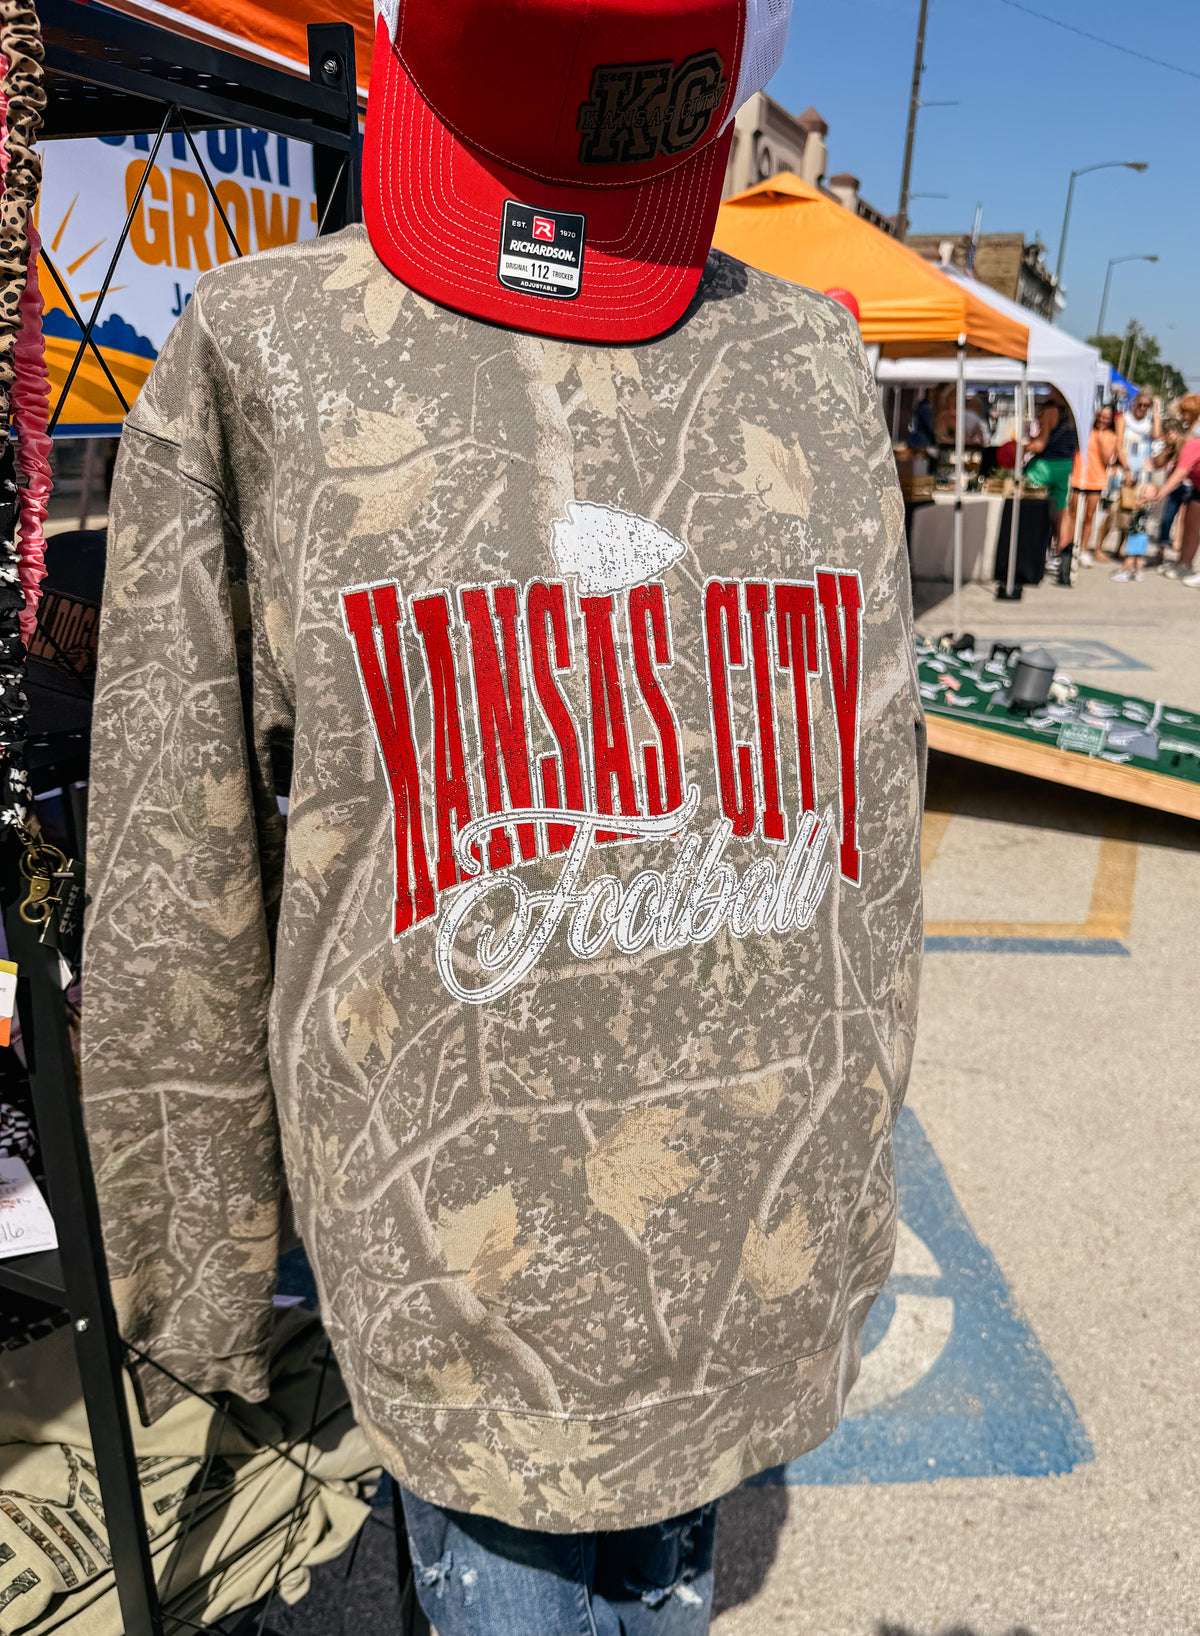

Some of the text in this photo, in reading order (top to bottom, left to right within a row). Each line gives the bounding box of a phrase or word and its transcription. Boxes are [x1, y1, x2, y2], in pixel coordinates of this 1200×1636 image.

[578, 48, 724, 165] KC
[582, 84, 727, 131] KANSAS CITY
[511, 220, 577, 239] EST. 1970
[505, 261, 575, 281] ORIGINAL 112 TRUCKER
[520, 281, 558, 292] ADJUSTABLE
[339, 566, 864, 943] KANSAS CITY
[435, 783, 835, 1006] Football
